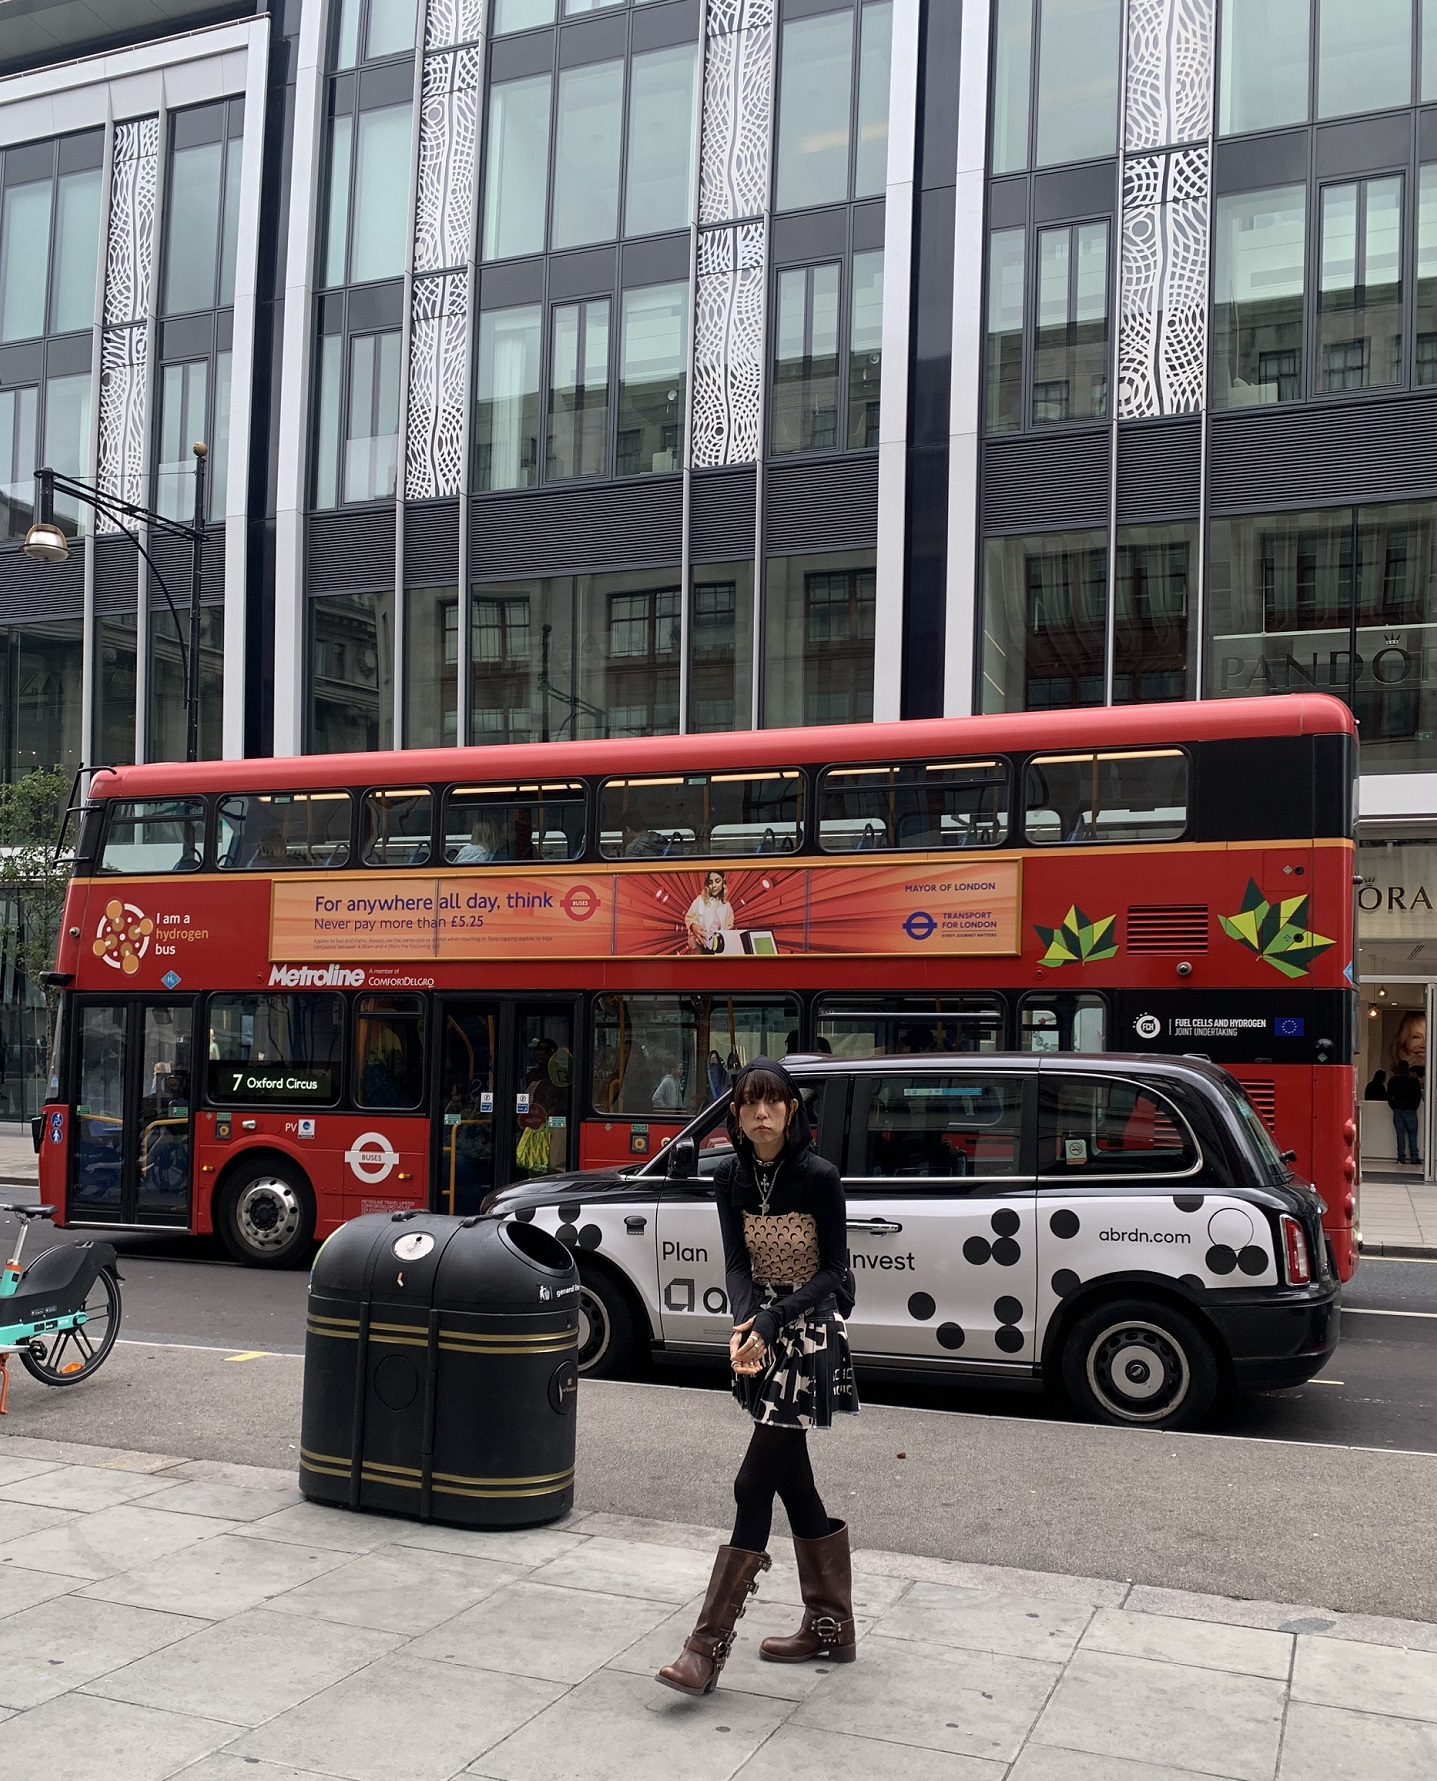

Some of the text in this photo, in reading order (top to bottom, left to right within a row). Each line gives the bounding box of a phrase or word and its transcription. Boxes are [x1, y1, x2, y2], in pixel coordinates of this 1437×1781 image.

[904, 882, 996, 893] MAYOR OF LONDON
[315, 891, 554, 915] For anywhere all day, think
[155, 912, 191, 924] I am a
[942, 911, 992, 919] TRANSPORT
[314, 915, 484, 932] Never pay more than £5.25
[942, 921, 958, 929] FOR
[155, 928, 209, 942] hydrogen
[155, 943, 176, 955] bus
[268, 964, 365, 987] Metroline
[1142, 1022, 1154, 1031] FCH
[1175, 1018, 1267, 1028] FUEL CELLS AND HYDROGEN
[1174, 1027, 1238, 1037] JOINT UNDERTAKING
[232, 1073, 318, 1091] 7 Oxford Circus
[285, 1122, 297, 1132] PV
[1099, 1227, 1191, 1244] abrdn.com
[663, 1241, 915, 1271] Plan Invest
[556, 1284, 575, 1298] general
